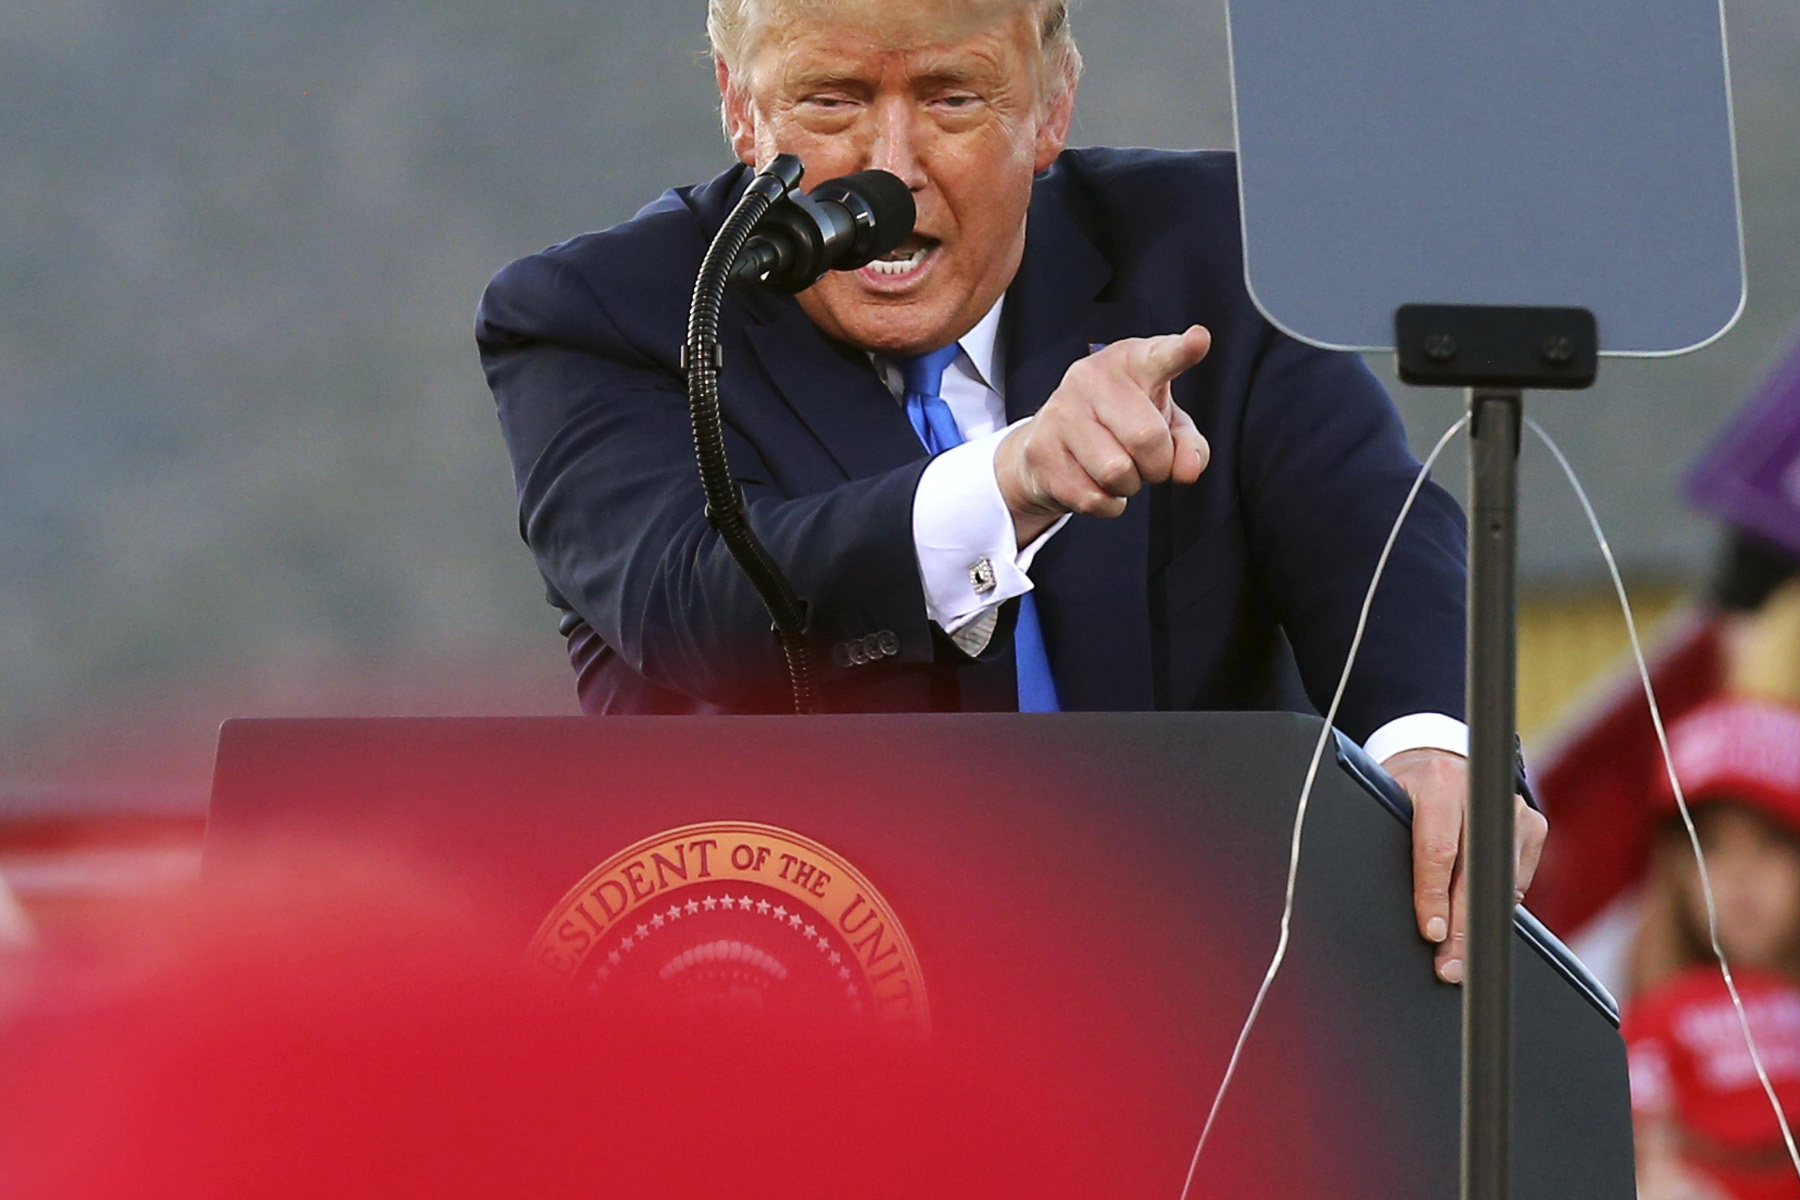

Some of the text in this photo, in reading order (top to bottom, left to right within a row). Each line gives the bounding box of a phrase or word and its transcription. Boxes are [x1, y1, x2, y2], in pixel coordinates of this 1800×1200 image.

[540, 838, 913, 1015] ESIDENT OF THE UNIT
